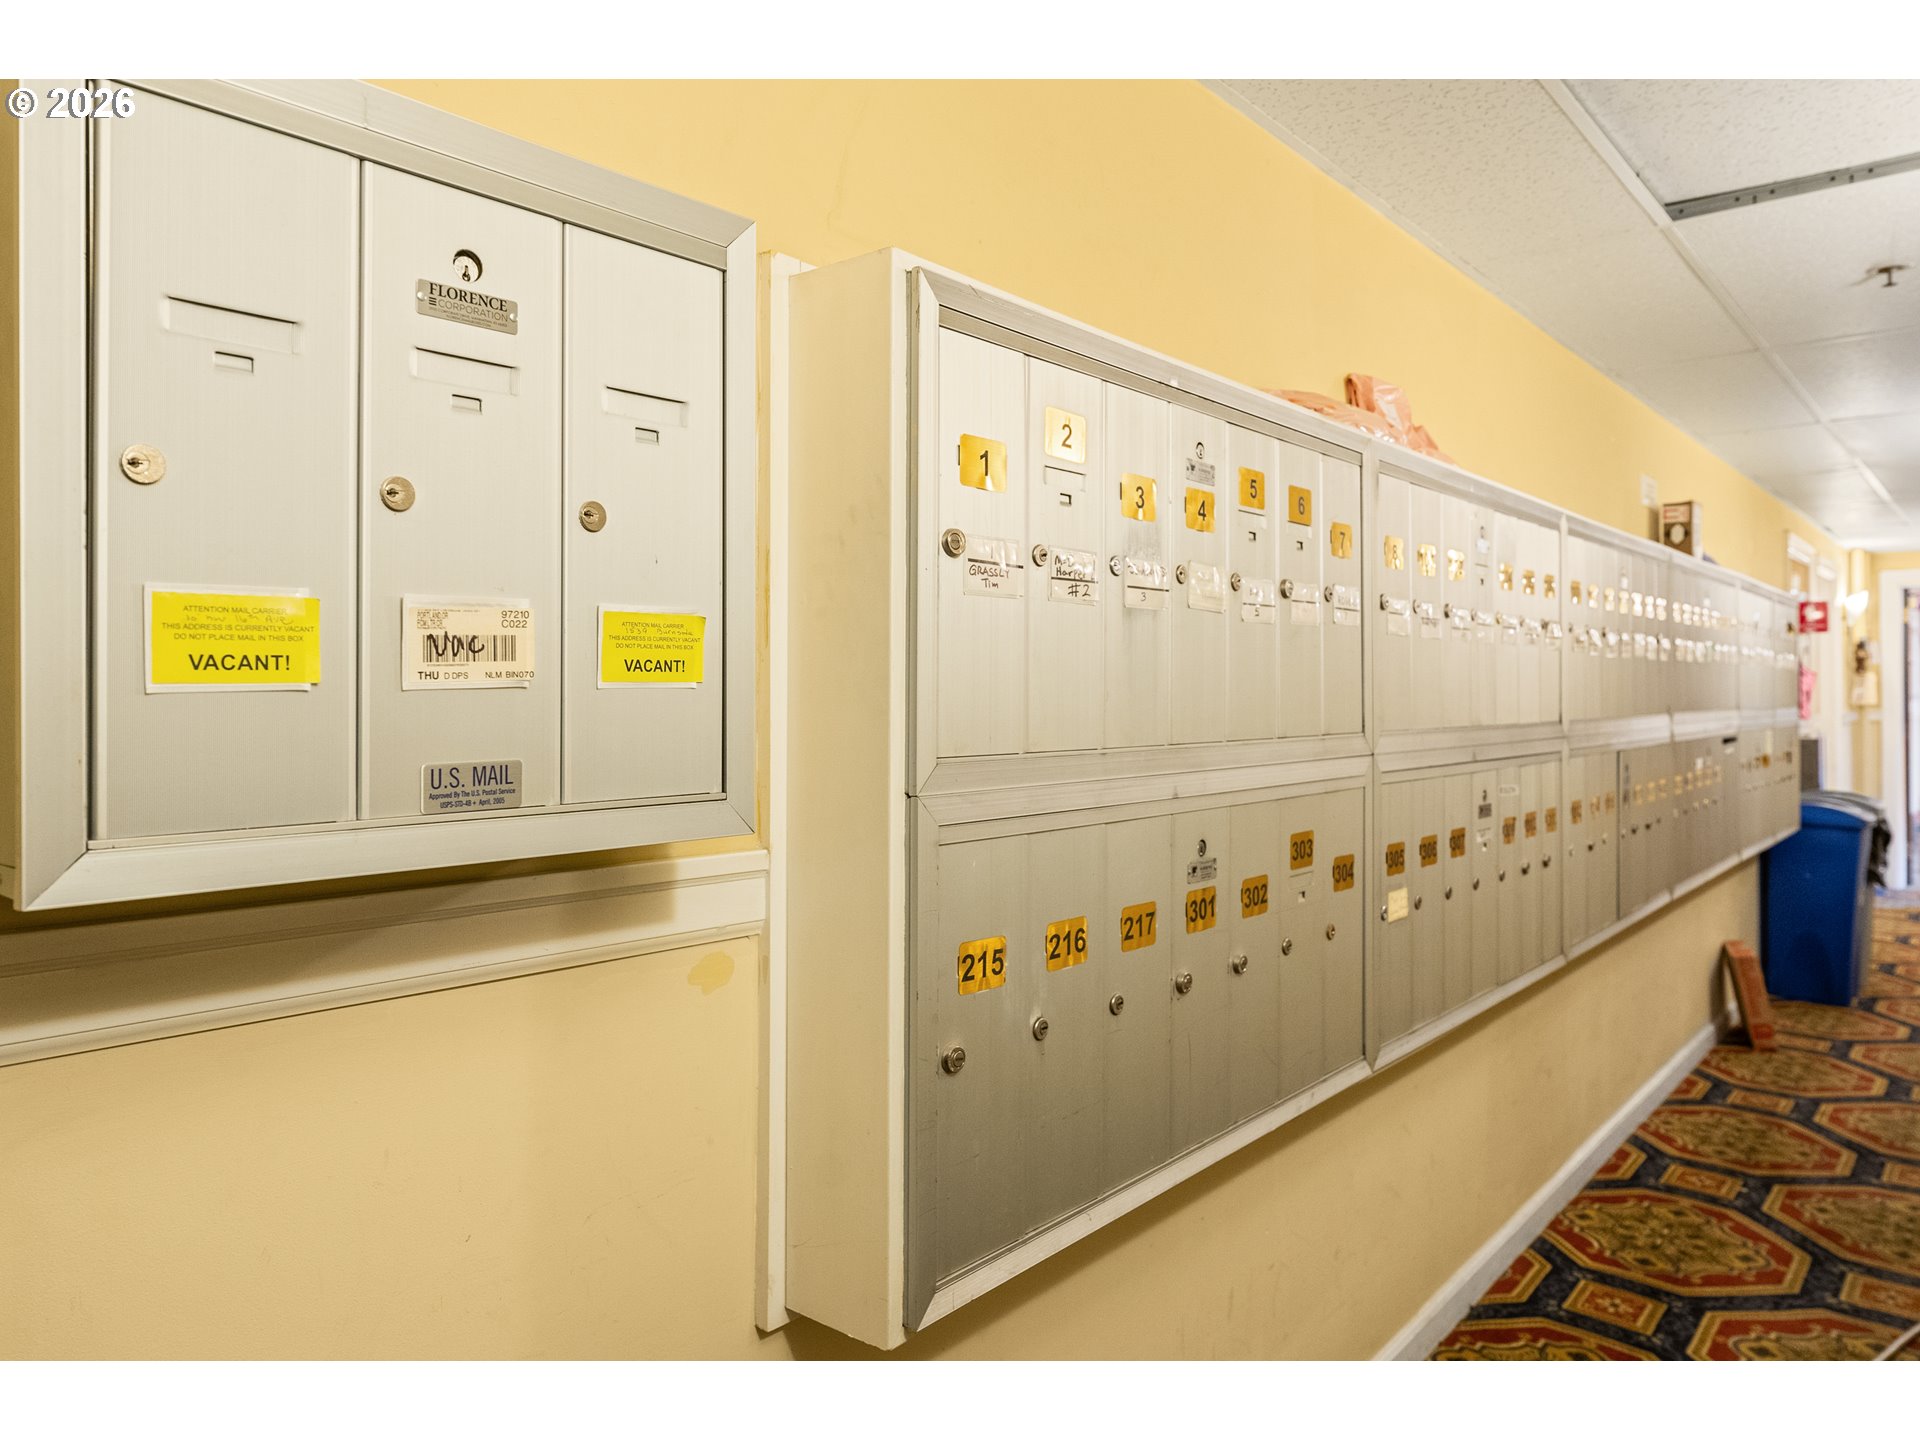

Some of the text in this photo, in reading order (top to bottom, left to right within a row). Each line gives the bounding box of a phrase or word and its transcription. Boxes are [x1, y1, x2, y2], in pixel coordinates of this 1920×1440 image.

[429, 282, 508, 312] FLORENCE
[438, 299, 508, 322] CORPORATION
[1061, 423, 1072, 449] 2
[980, 450, 989, 477] 1
[1135, 486, 1145, 509] 3
[1249, 479, 1258, 499] 5
[1197, 500, 1207, 521] 4
[1298, 496, 1305, 515] 6
[1339, 532, 1345, 550] 7
[981, 577, 999, 589] Tim
[1067, 583, 1091, 597] #2
[1140, 591, 1147, 602] 3
[183, 605, 289, 616] ATTENTION MAIL CARRIER
[501, 610, 530, 620] 97210
[161, 622, 181, 630] THIS
[182, 623, 223, 631] ADDRESS
[234, 624, 281, 632] CURRENTLY
[284, 625, 315, 633] VACANT
[501, 619, 528, 629] C022
[173, 632, 187, 640] DO
[188, 633, 206, 641] NOT
[208, 633, 235, 641] PLACE
[237, 634, 256, 642] MAIL
[268, 634, 286, 642] THIS
[652, 635, 681, 643] CURRENTLY
[188, 653, 290, 671] VACANT!
[623, 658, 686, 673] VACANT!
[417, 671, 439, 680] THU
[485, 671, 502, 679] NLM
[505, 670, 535, 679] BIN070
[430, 764, 514, 790] U.S. MAIL
[428, 792, 452, 801] Approved
[453, 791, 460, 799] By
[481, 788, 498, 796] Postal
[498, 787, 516, 795] Service
[1291, 838, 1313, 861] 303
[1334, 861, 1354, 883] 304
[1243, 883, 1268, 909] 302
[1189, 894, 1216, 923] 301
[1123, 911, 1155, 941] 217
[1048, 927, 1086, 961] 216
[961, 948, 1004, 983] 215
